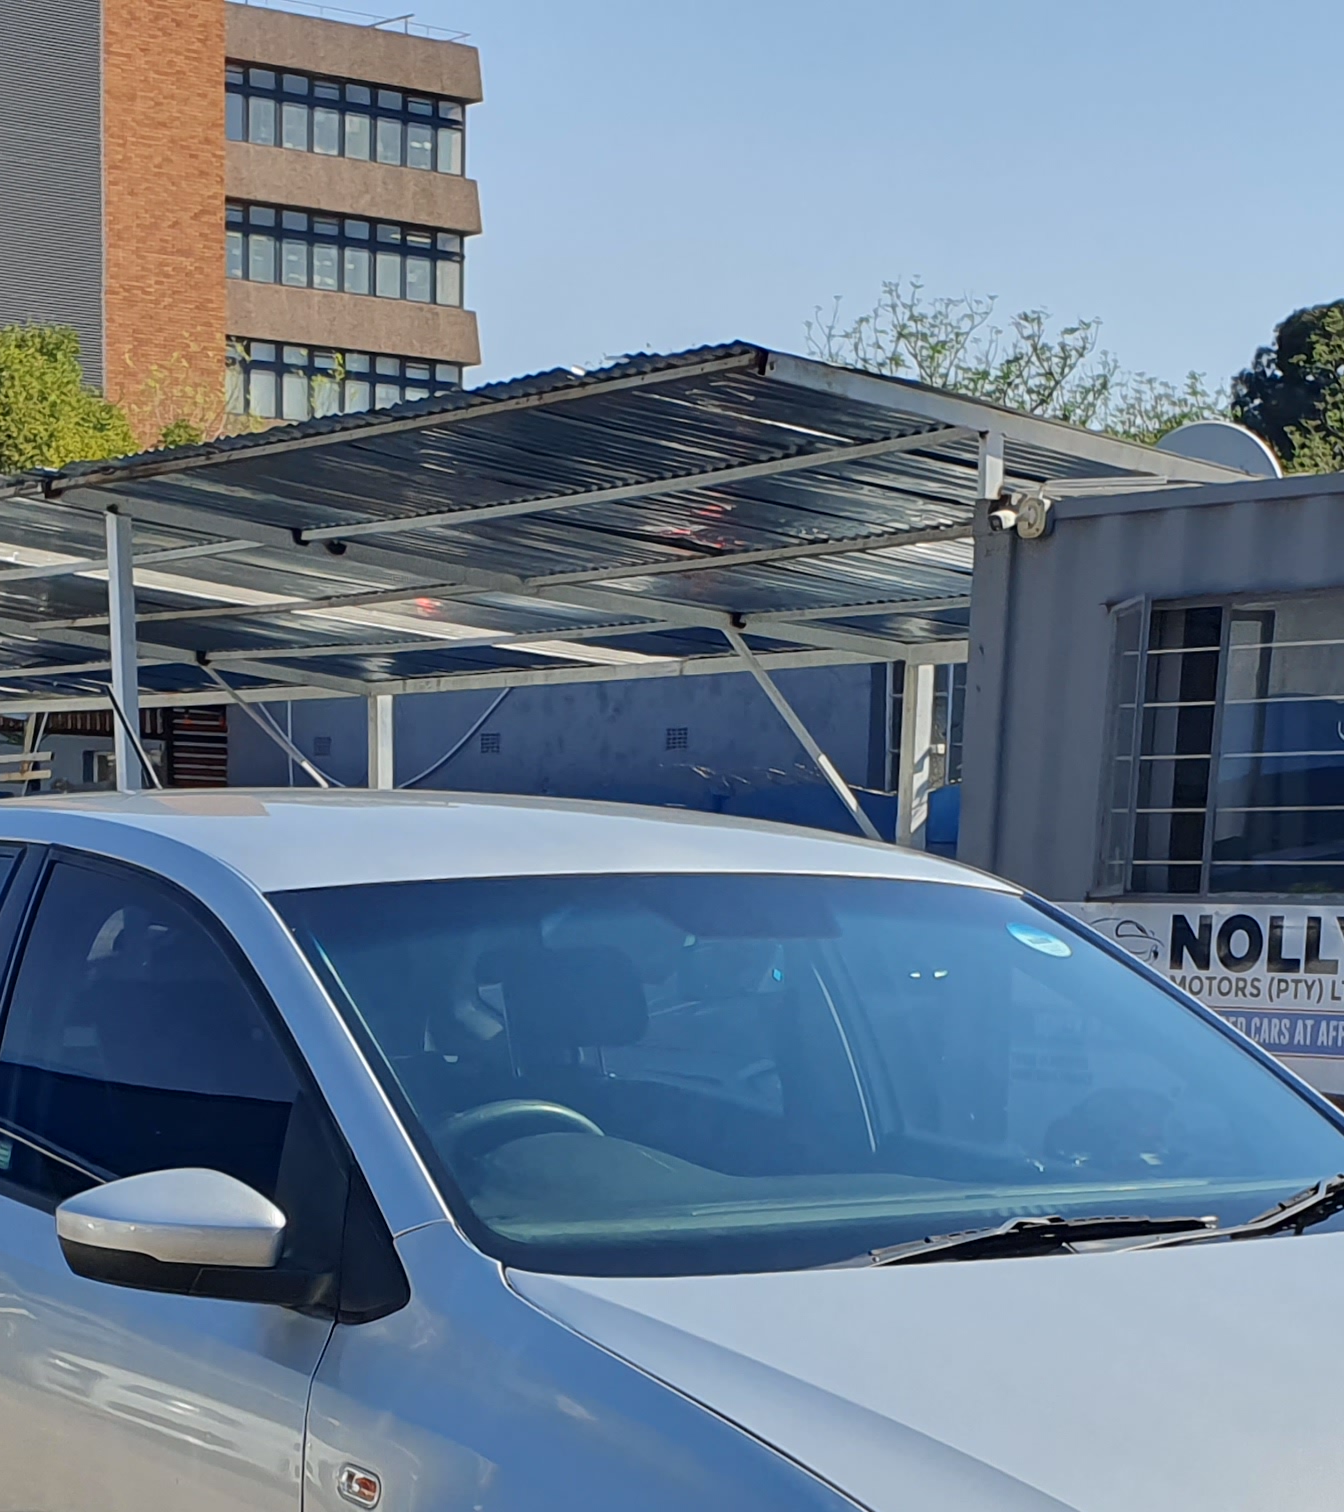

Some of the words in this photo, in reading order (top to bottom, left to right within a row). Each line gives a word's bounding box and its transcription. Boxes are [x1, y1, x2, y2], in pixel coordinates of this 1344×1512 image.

[1169, 974, 1261, 999] MOTORS
[1267, 976, 1323, 1003] (PTY)
[1251, 1017, 1290, 1045] CARS
[1293, 1019, 1314, 1046] AT
